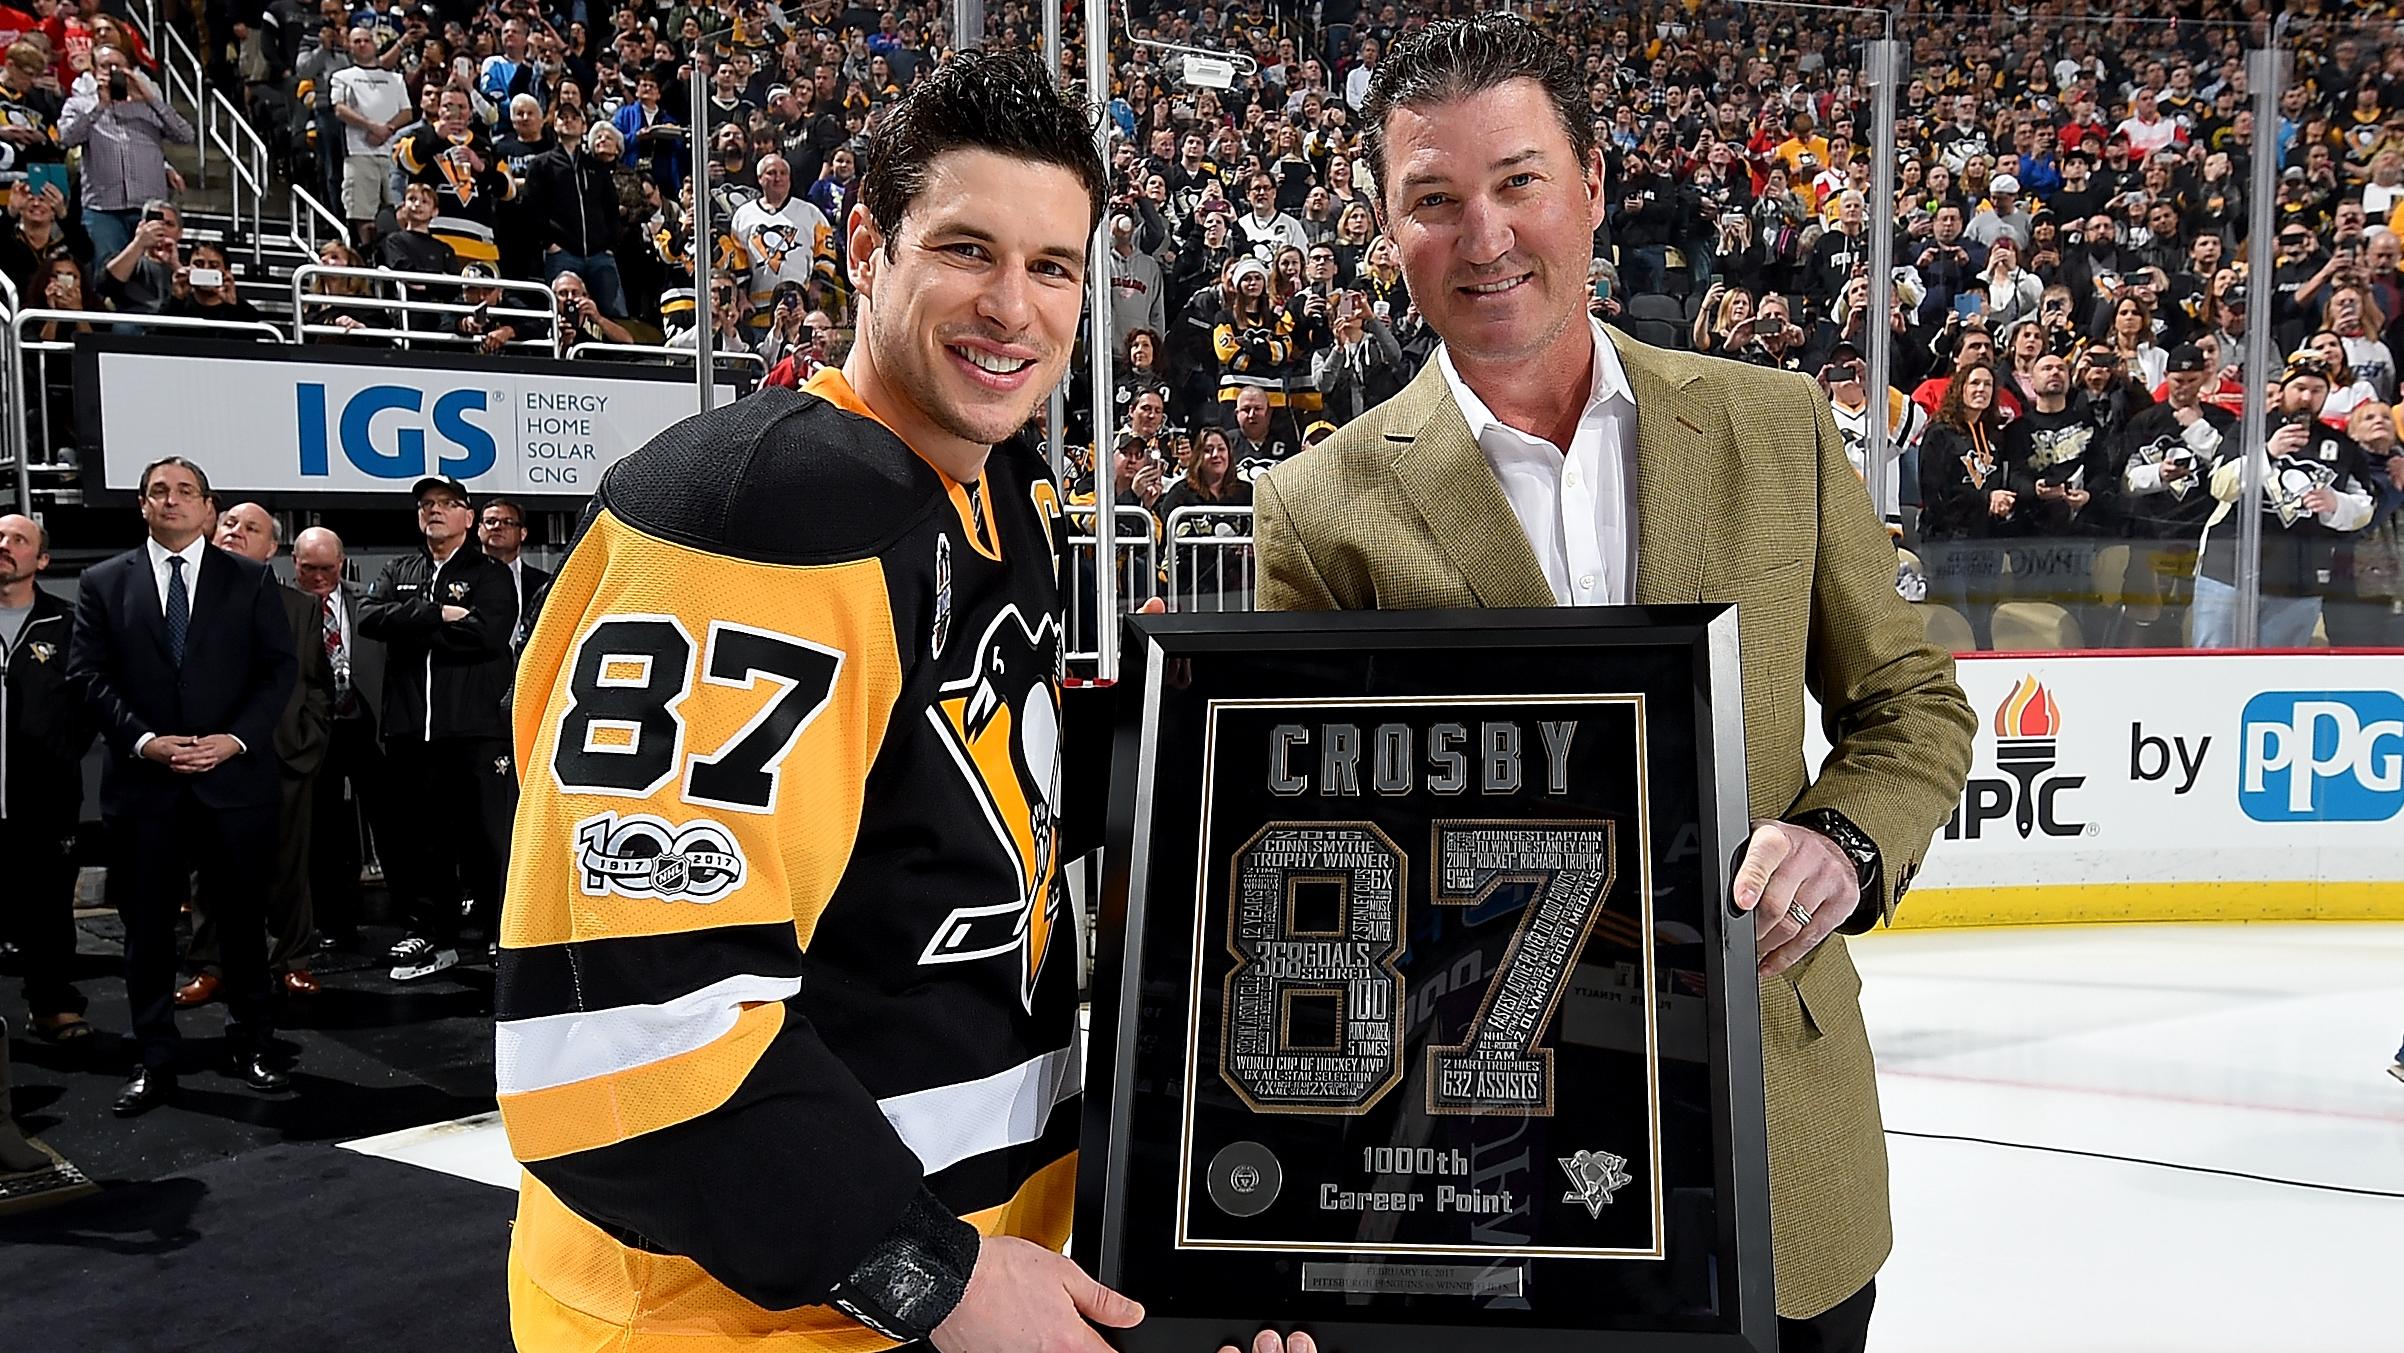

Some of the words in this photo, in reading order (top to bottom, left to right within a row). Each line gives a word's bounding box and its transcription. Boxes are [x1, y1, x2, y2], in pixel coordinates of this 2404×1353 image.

[526, 393, 609, 413] ENERGY
[296, 382, 497, 480] IGS
[527, 418, 590, 436] HOME
[527, 442, 596, 461] SOLAR
[529, 467, 578, 484] CNG
[550, 613, 847, 815] 87
[1268, 720, 1578, 797] CROSBY
[2129, 721, 2212, 795] by
[2244, 701, 2404, 813] PPG
[1474, 831, 1542, 841] YOUNGEST
[1545, 831, 1602, 841] CAPTAIN
[1265, 840, 1308, 852] CONN
[1313, 840, 1375, 853] SMYTHE
[1476, 841, 1489, 852] TO
[1491, 841, 1510, 852] WIN
[1514, 841, 1531, 852] THE
[1533, 841, 1576, 853] STANLEY
[1578, 841, 1599, 853] CUP
[600, 859, 644, 871] 1917
[693, 855, 732, 867] 2017
[1251, 853, 1317, 867] TROPHY
[1323, 853, 1389, 868] WINNER
[1447, 853, 1470, 868] 2010
[1520, 853, 1561, 870] RICHARD
[1564, 853, 1603, 870] TROPHY
[658, 862, 683, 884] NHL
[1354, 869, 1370, 892] CUPS
[1371, 869, 1393, 890] 6X
[1447, 869, 1456, 889] 9
[1572, 870, 1588, 895] POINTS
[1548, 868, 1576, 904] POINTS
[1244, 890, 1263, 925] YEARS
[1352, 894, 1370, 931] STANLEY
[1538, 897, 1562, 923] 1000
[1242, 926, 1261, 938] 12
[1367, 921, 1391, 941] PLAYER
[1532, 917, 1553, 936] TO
[1352, 933, 1368, 941] 2
[1512, 1029, 1526, 1043] 2
[1519, 964, 1556, 1030] OLYMPIC
[1548, 925, 1575, 965] GOLD
[1568, 868, 1602, 925] MEDALS
[1517, 929, 1547, 966] PLAYER
[1255, 941, 1302, 978] 368
[1303, 942, 1370, 968] GOALS
[1302, 968, 1370, 980] SCORED
[1504, 959, 1533, 994] ACTIVE
[1349, 979, 1387, 1020] 100
[1487, 988, 1519, 1030] FASTEST
[1484, 1032, 1506, 1040] NHL
[1348, 1041, 1355, 1056] 5
[1358, 1041, 1388, 1056] TIMES
[1477, 1050, 1515, 1060] TEAM
[1237, 1056, 1273, 1070] WORLD
[1276, 1057, 1298, 1071] CUP
[1300, 1057, 1314, 1071] OF
[1316, 1058, 1358, 1072] HOCKEY
[1361, 1058, 1384, 1073] MVP
[1443, 1059, 1451, 1068] 2
[1454, 1059, 1481, 1070] HART
[1486, 1061, 1540, 1071] TROPHIES
[1261, 1070, 1312, 1081] ALL-STAR
[1315, 1071, 1372, 1082] SELECTION
[1443, 1070, 1472, 1098] 632
[1477, 1071, 1538, 1099] ASSISTS
[1254, 1081, 1274, 1095] 4X
[1310, 1081, 1328, 1096] 2X
[1363, 1147, 1468, 1176] 1000th
[1320, 1183, 1424, 1212] Career
[1437, 1185, 1514, 1214] Point
[1367, 1267, 1417, 1277] FEBRUARY
[1434, 1268, 1454, 1278] 2017
[1313, 1278, 1372, 1288] PITTSBURGH
[1375, 1279, 1423, 1289] PENGUINS
